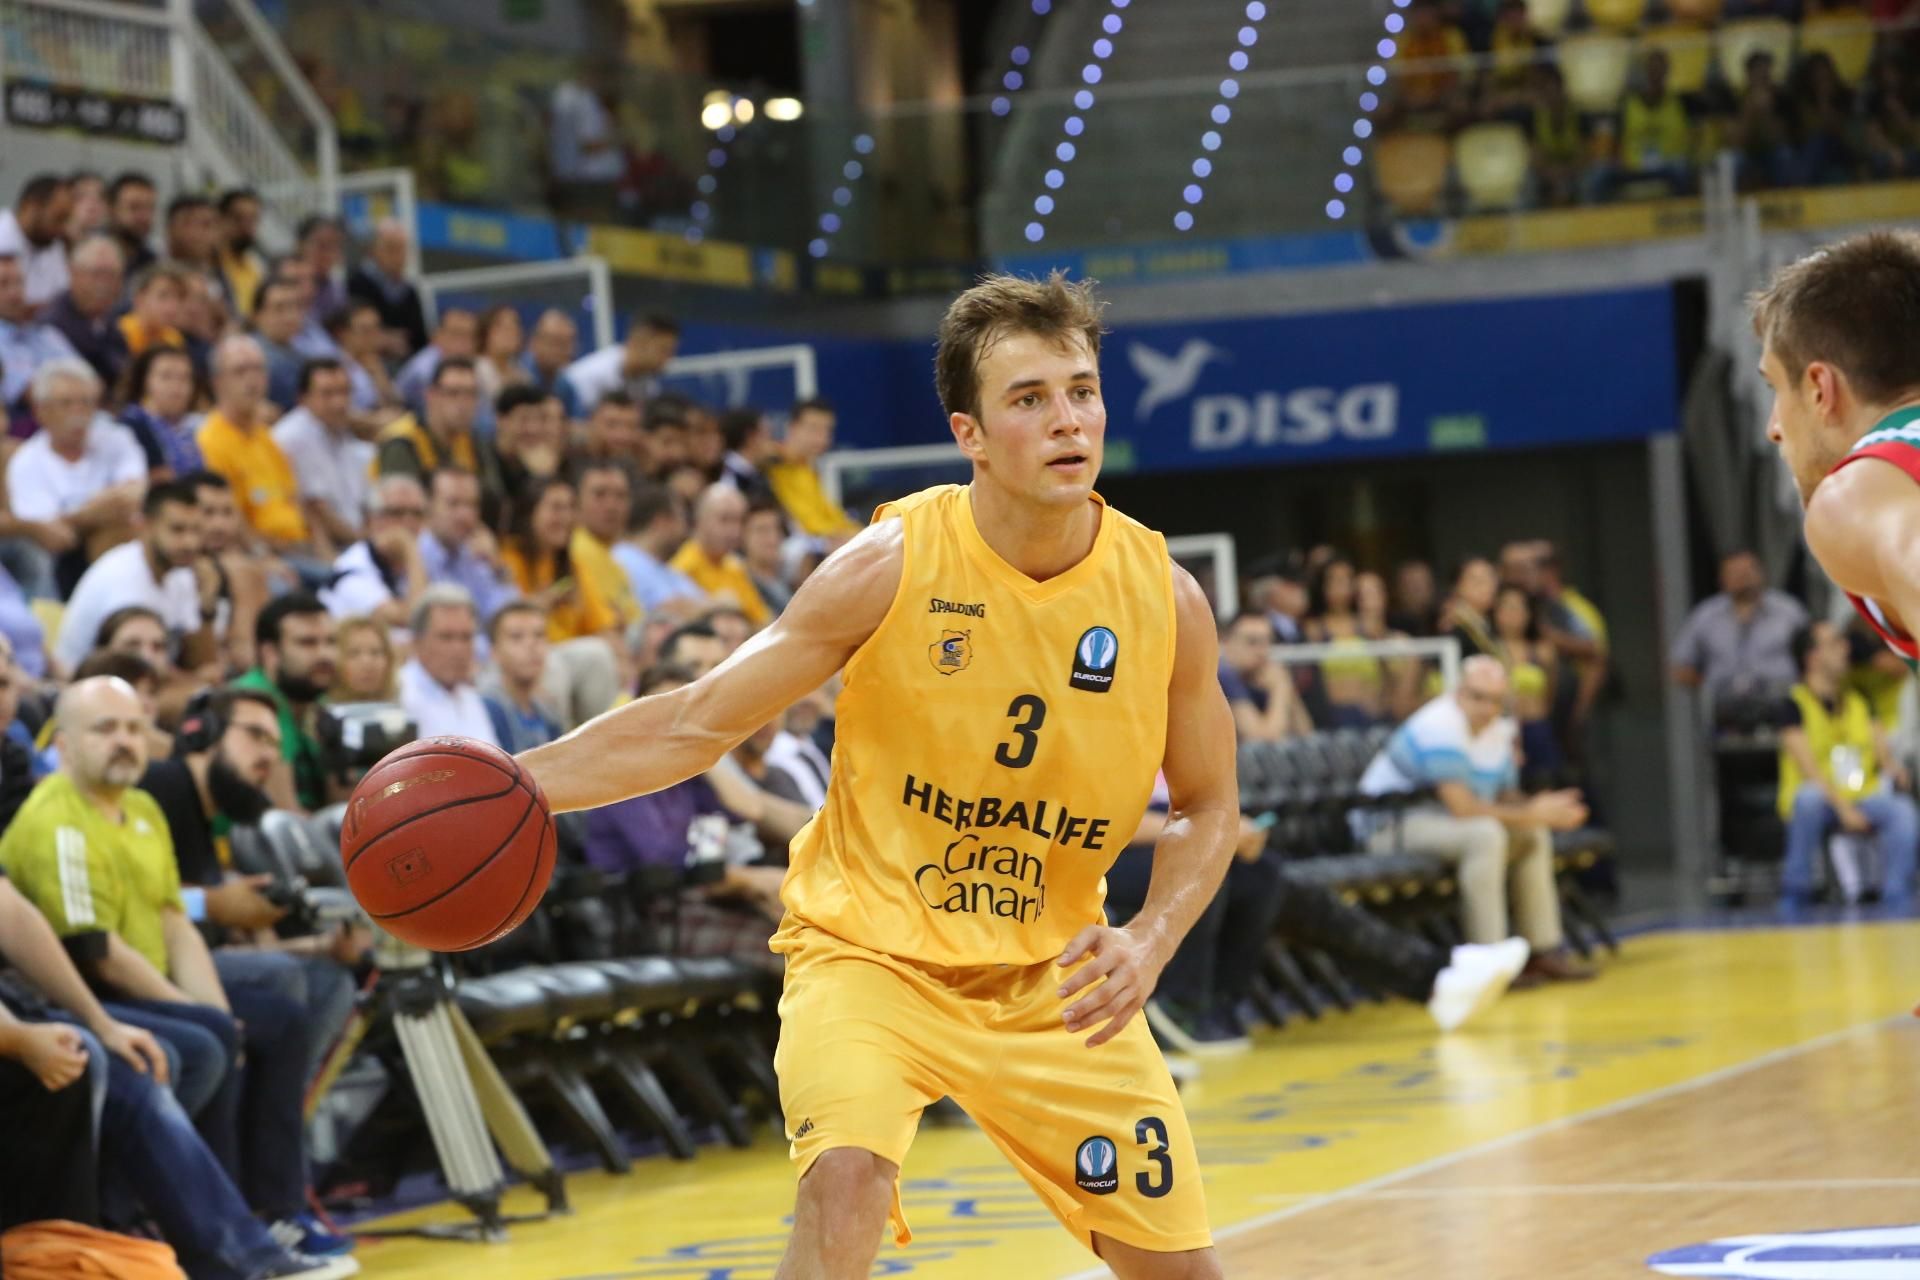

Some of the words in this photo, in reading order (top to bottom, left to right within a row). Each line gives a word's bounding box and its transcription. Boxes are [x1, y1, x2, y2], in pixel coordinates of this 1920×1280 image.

[928, 598, 985, 618] SPALDING
[1073, 671, 1112, 683] EUROCUP
[994, 694, 1047, 769] 3
[902, 774, 1111, 850] HERBALIFE
[944, 834, 1042, 887] Gran
[1078, 1179, 1117, 1188] EUROCUP
[1135, 1116, 1174, 1198] 3
